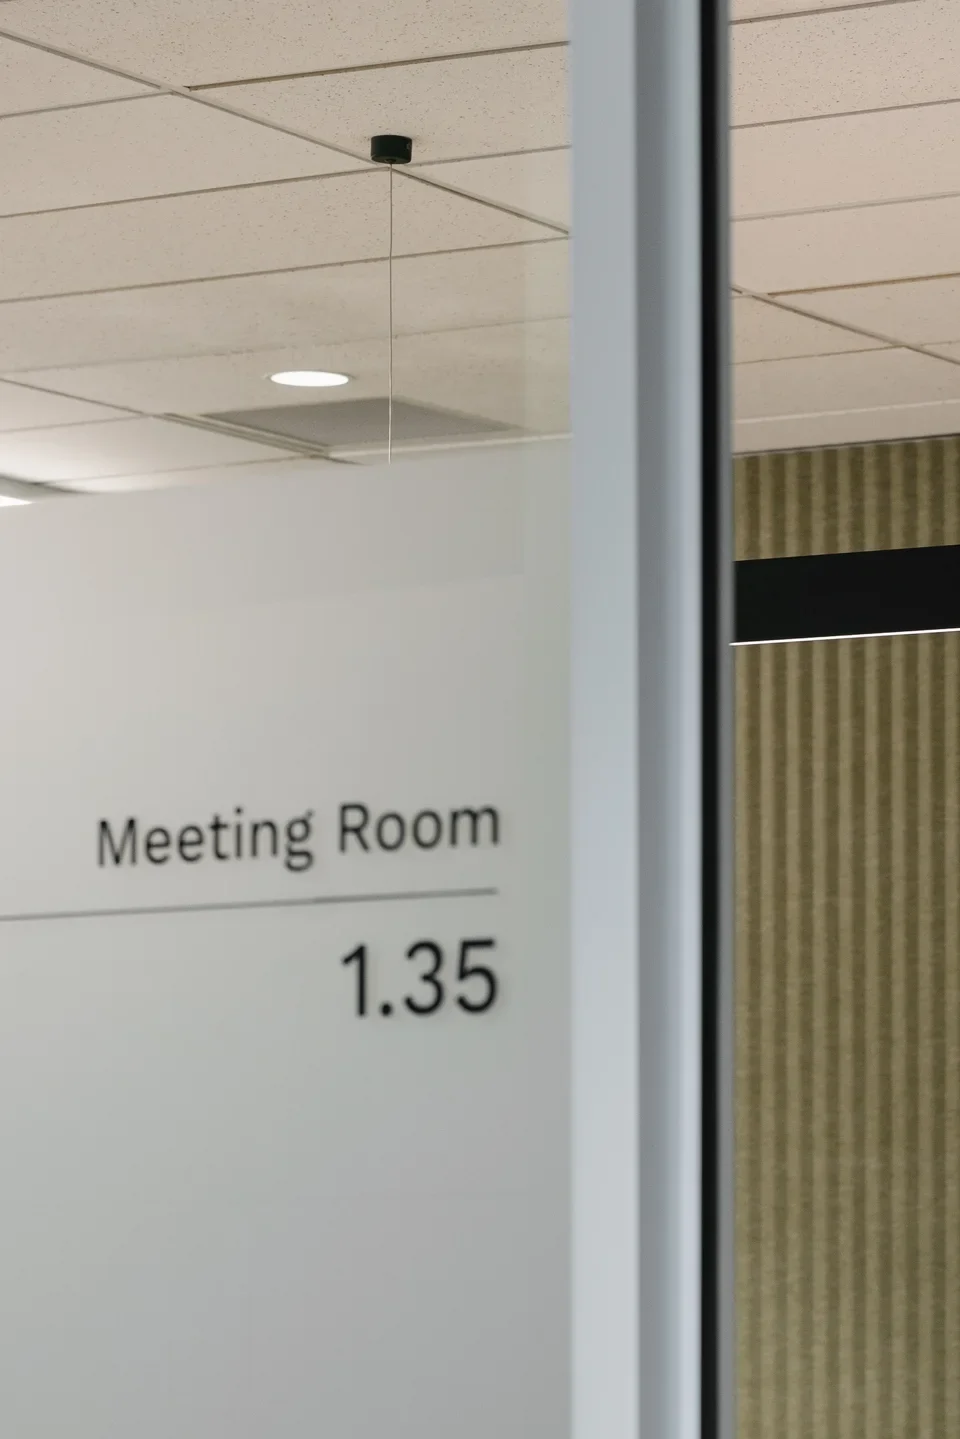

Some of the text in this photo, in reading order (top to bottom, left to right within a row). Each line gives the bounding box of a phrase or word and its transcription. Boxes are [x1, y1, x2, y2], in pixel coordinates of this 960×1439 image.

[97, 802, 501, 874] Meeting Room
[341, 936, 500, 1019] 1.35
